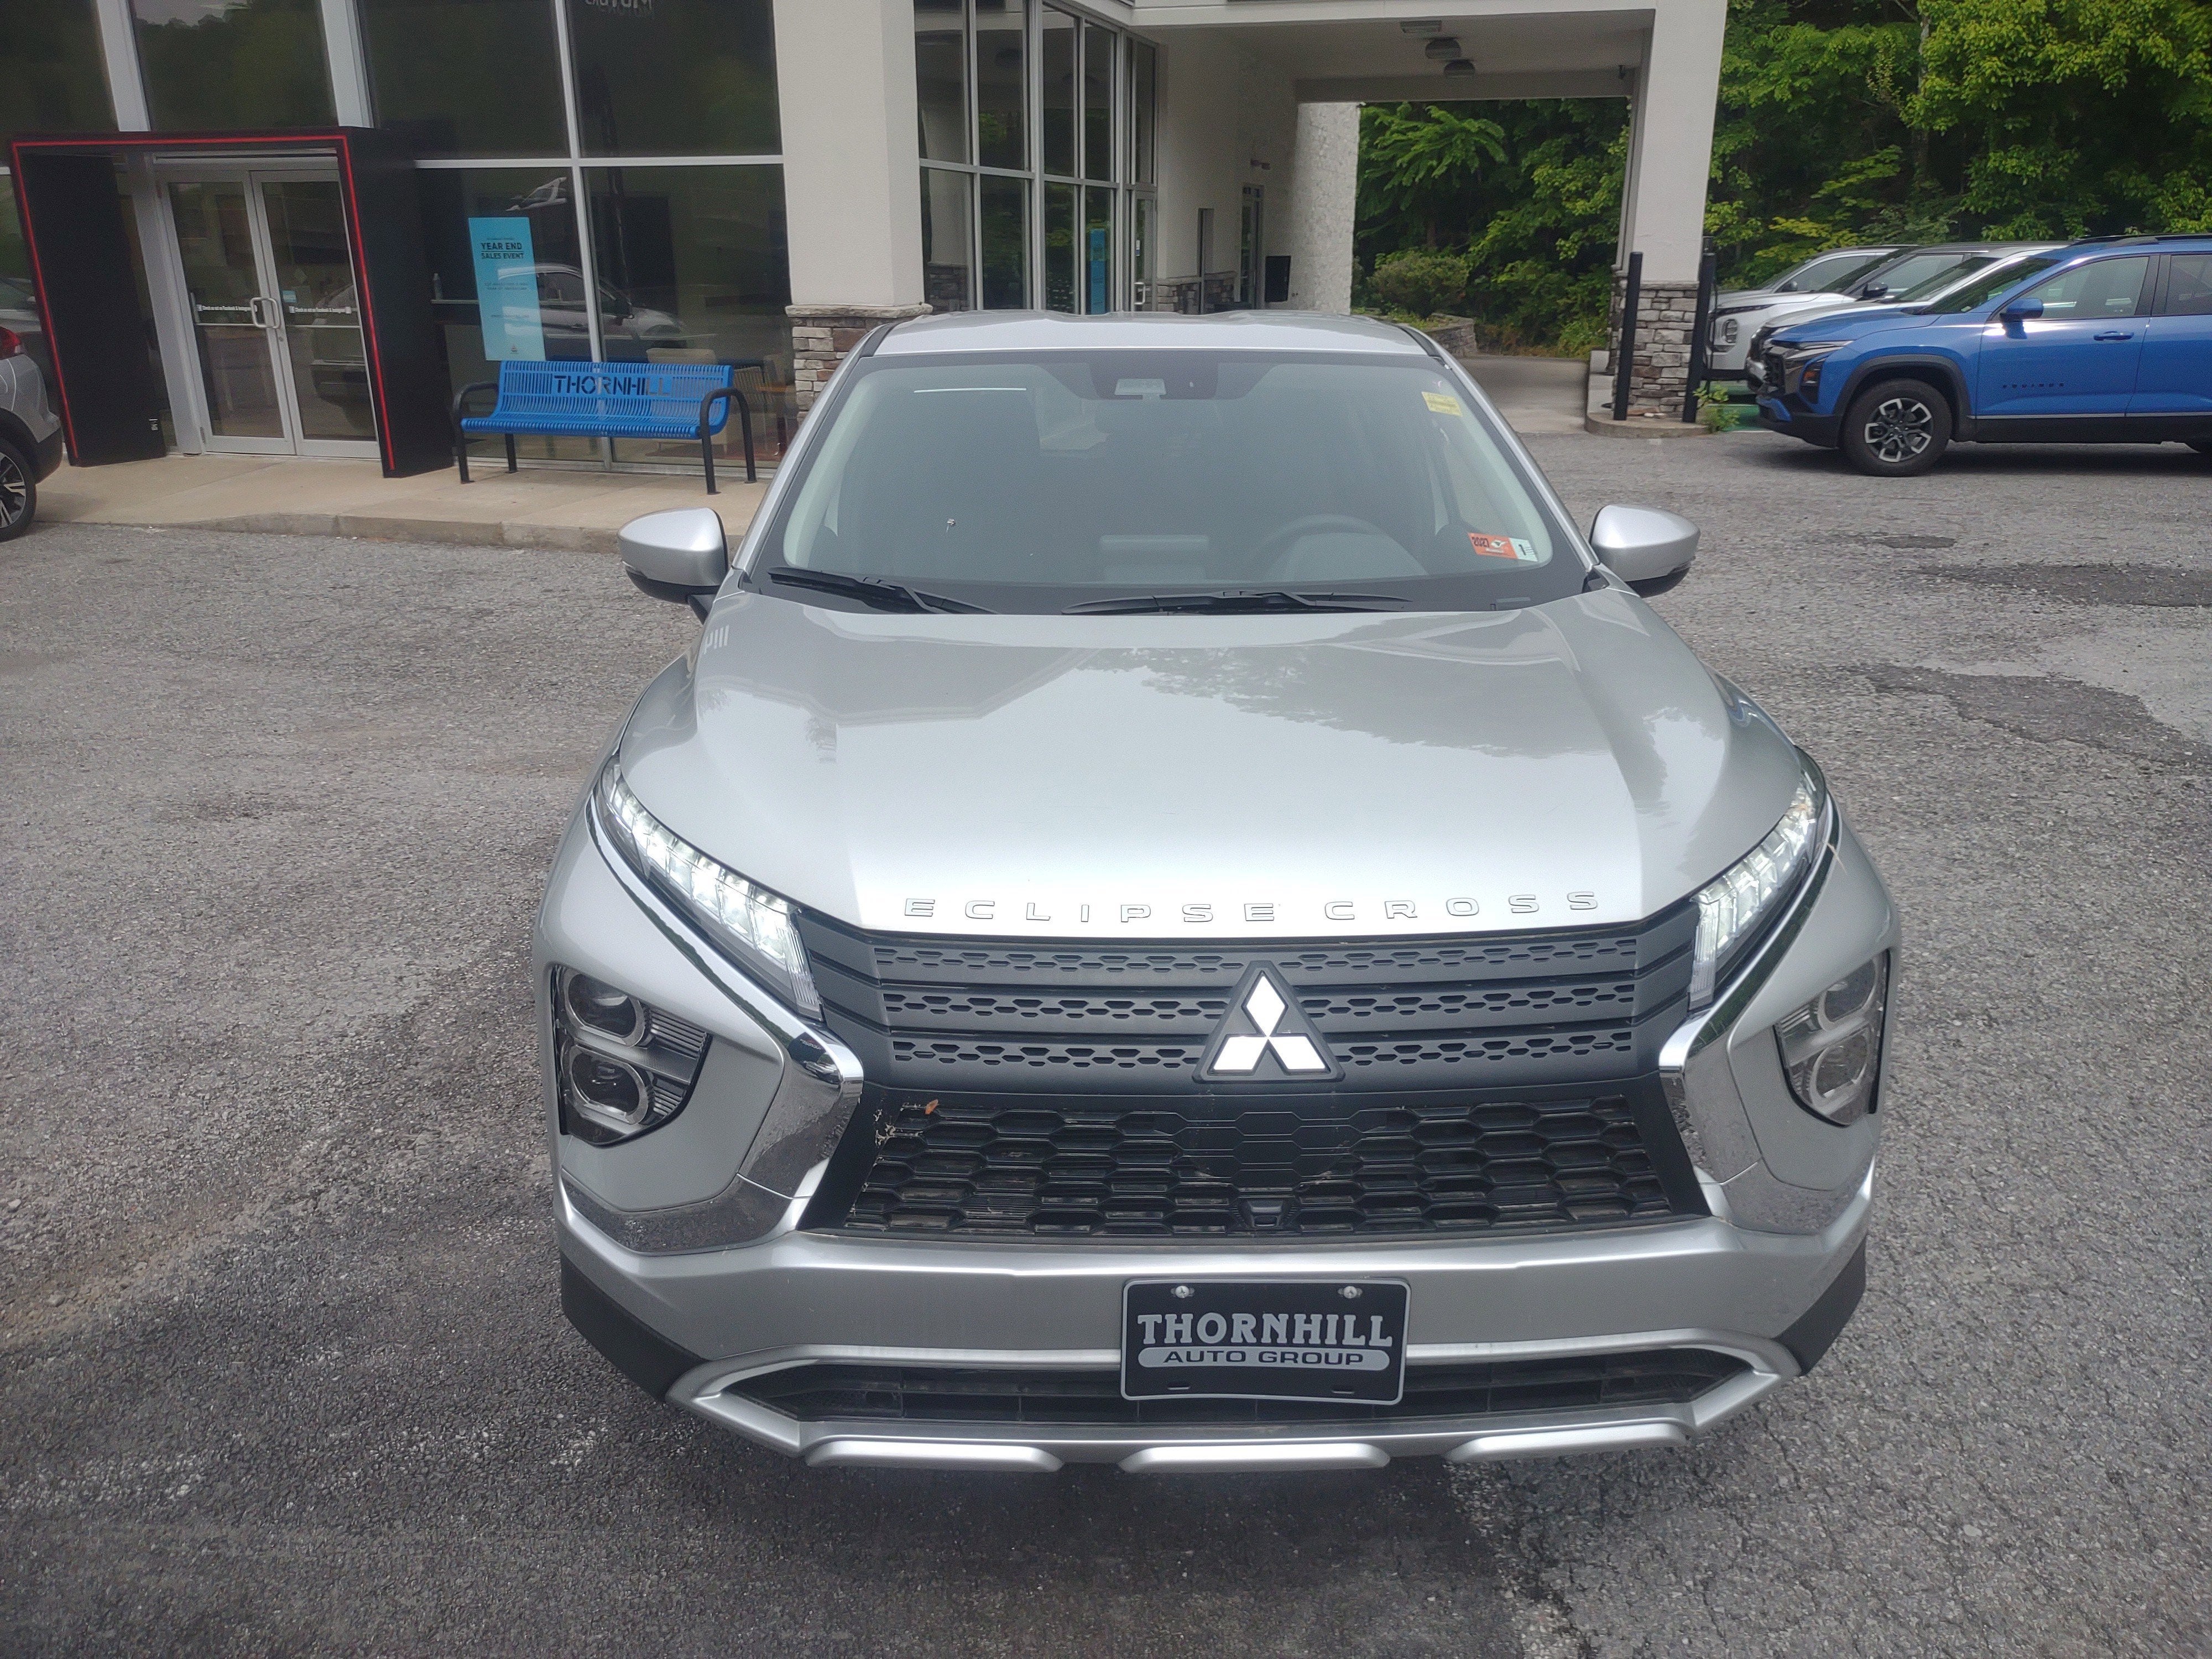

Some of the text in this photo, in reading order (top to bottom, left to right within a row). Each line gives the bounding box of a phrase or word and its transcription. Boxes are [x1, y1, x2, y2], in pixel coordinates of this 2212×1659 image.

[554, 375, 671, 396] THORNHILL
[904, 891, 1599, 923] ECLIPSE CROSS
[1138, 1312, 1392, 1347] THORNHILL
[1162, 1350, 1364, 1365] AUTO GROUP
